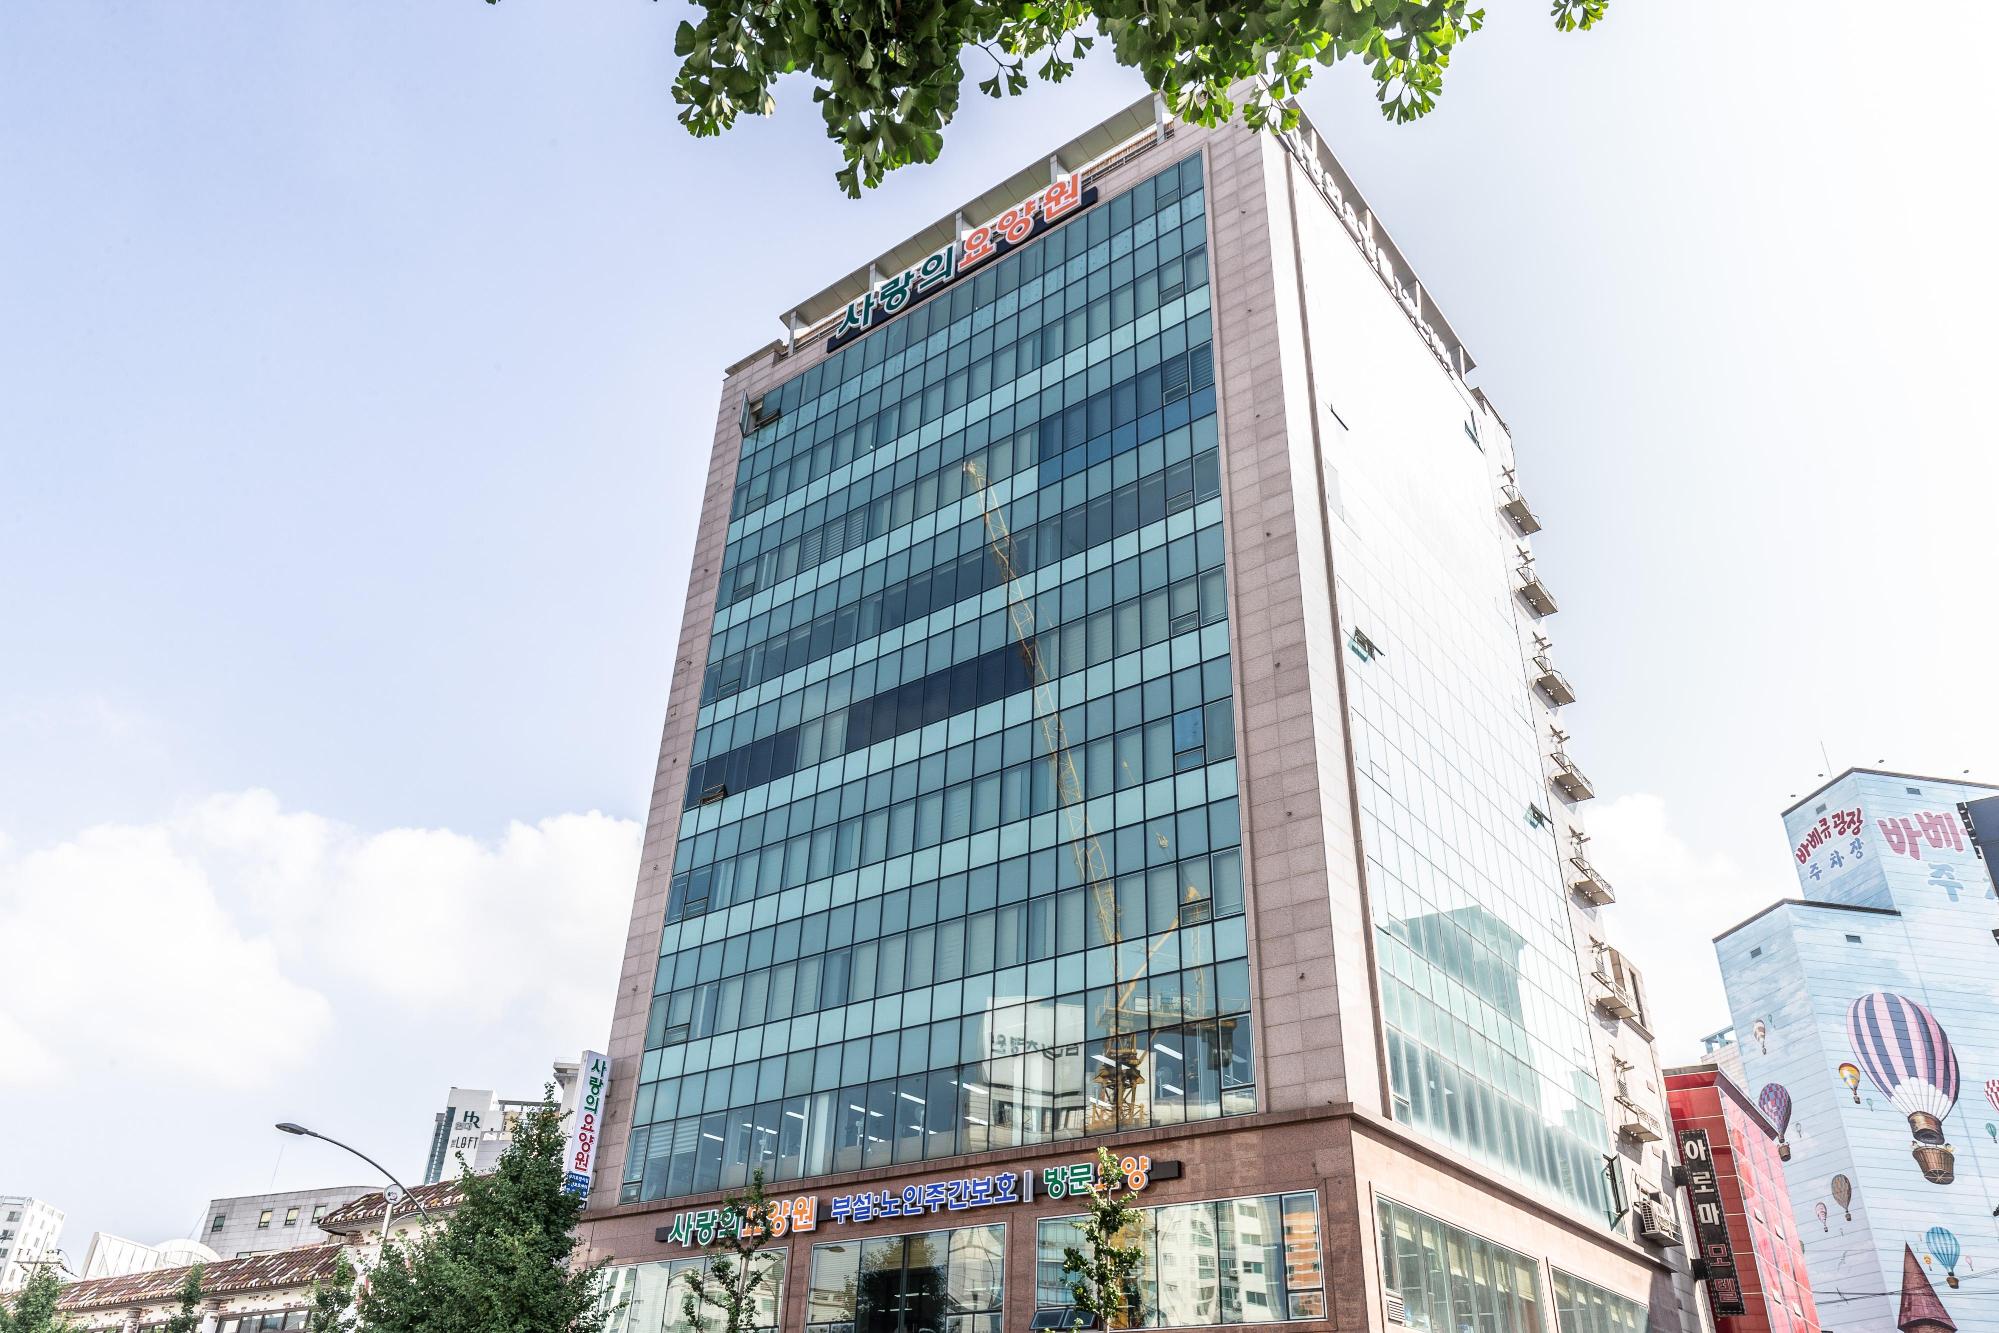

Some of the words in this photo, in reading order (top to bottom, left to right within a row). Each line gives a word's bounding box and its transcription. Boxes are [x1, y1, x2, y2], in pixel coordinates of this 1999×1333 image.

[455, 1136, 479, 1149] LOFT
[1685, 1139, 1720, 1226] 아로마
[1707, 1243, 1739, 1303] 모텔
